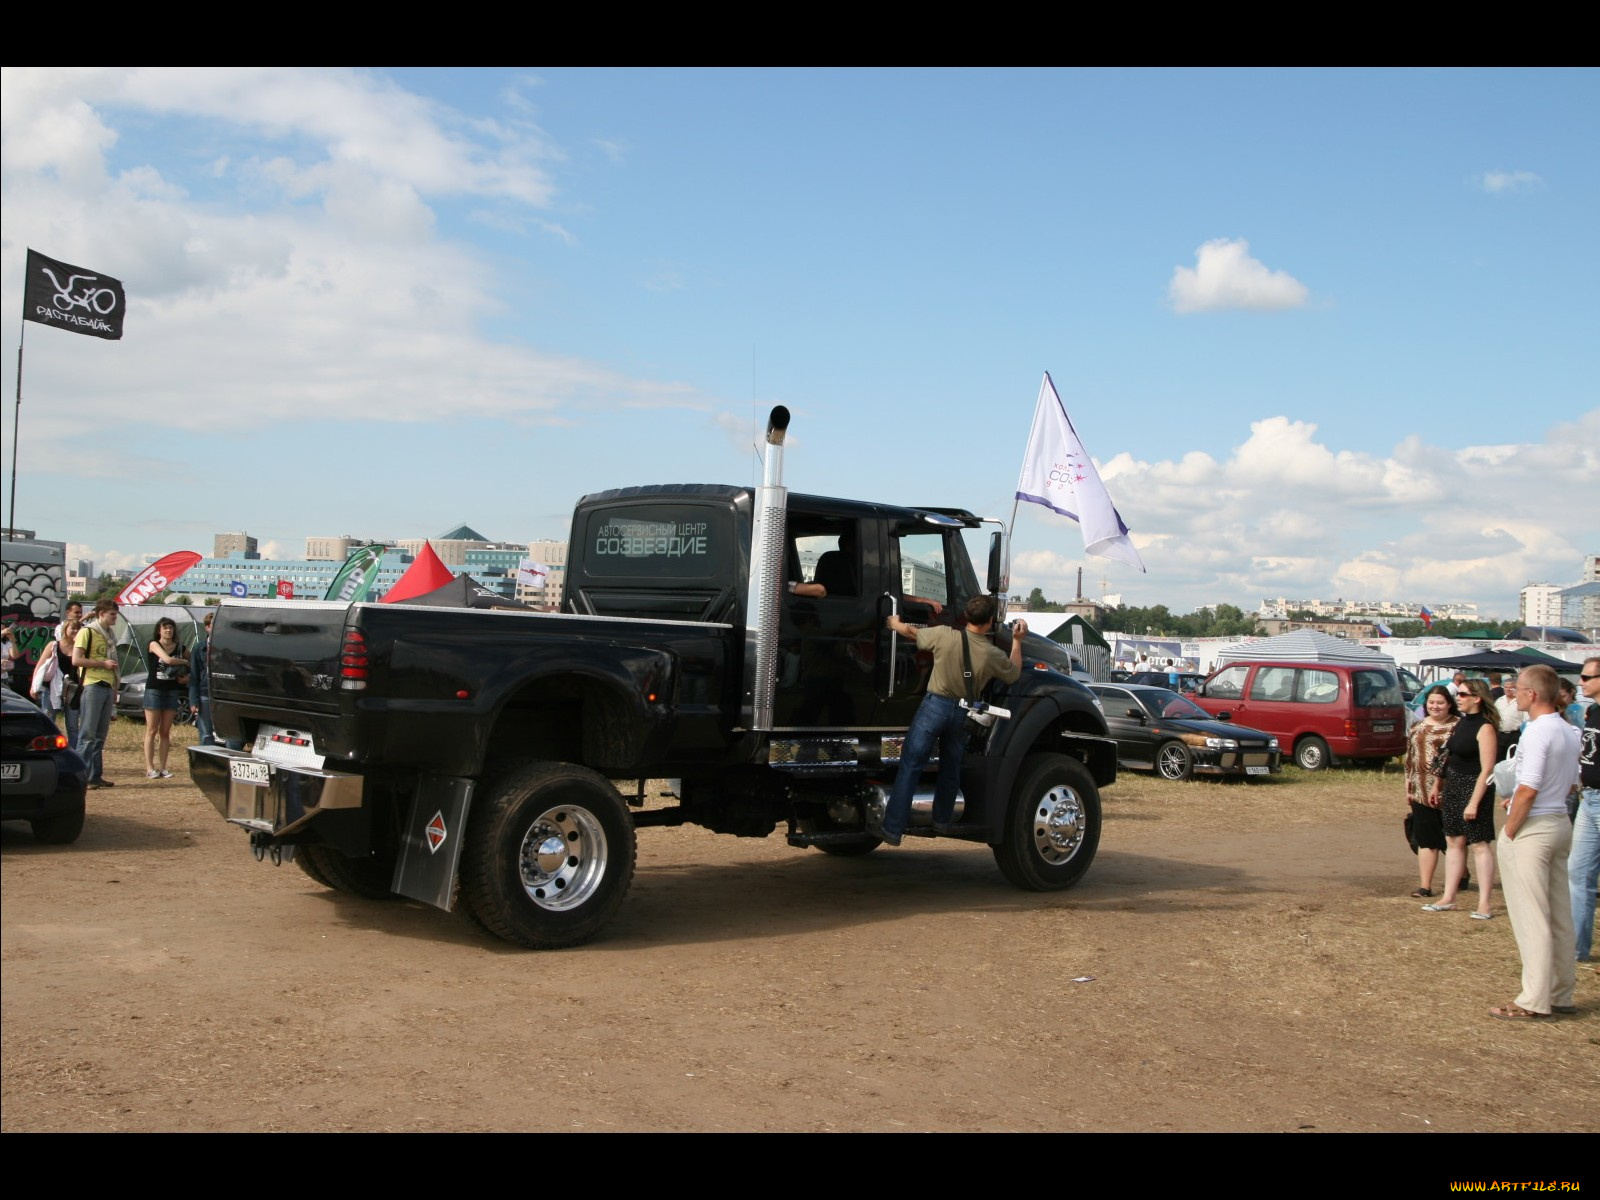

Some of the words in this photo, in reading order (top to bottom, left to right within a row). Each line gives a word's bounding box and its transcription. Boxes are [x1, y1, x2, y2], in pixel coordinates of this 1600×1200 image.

[598, 521, 676, 537] АВТОСЕРВИСНЫЙ
[678, 523, 707, 536] ЦЕНТР
[596, 537, 707, 557] СОЗВЕЗДИЕ
